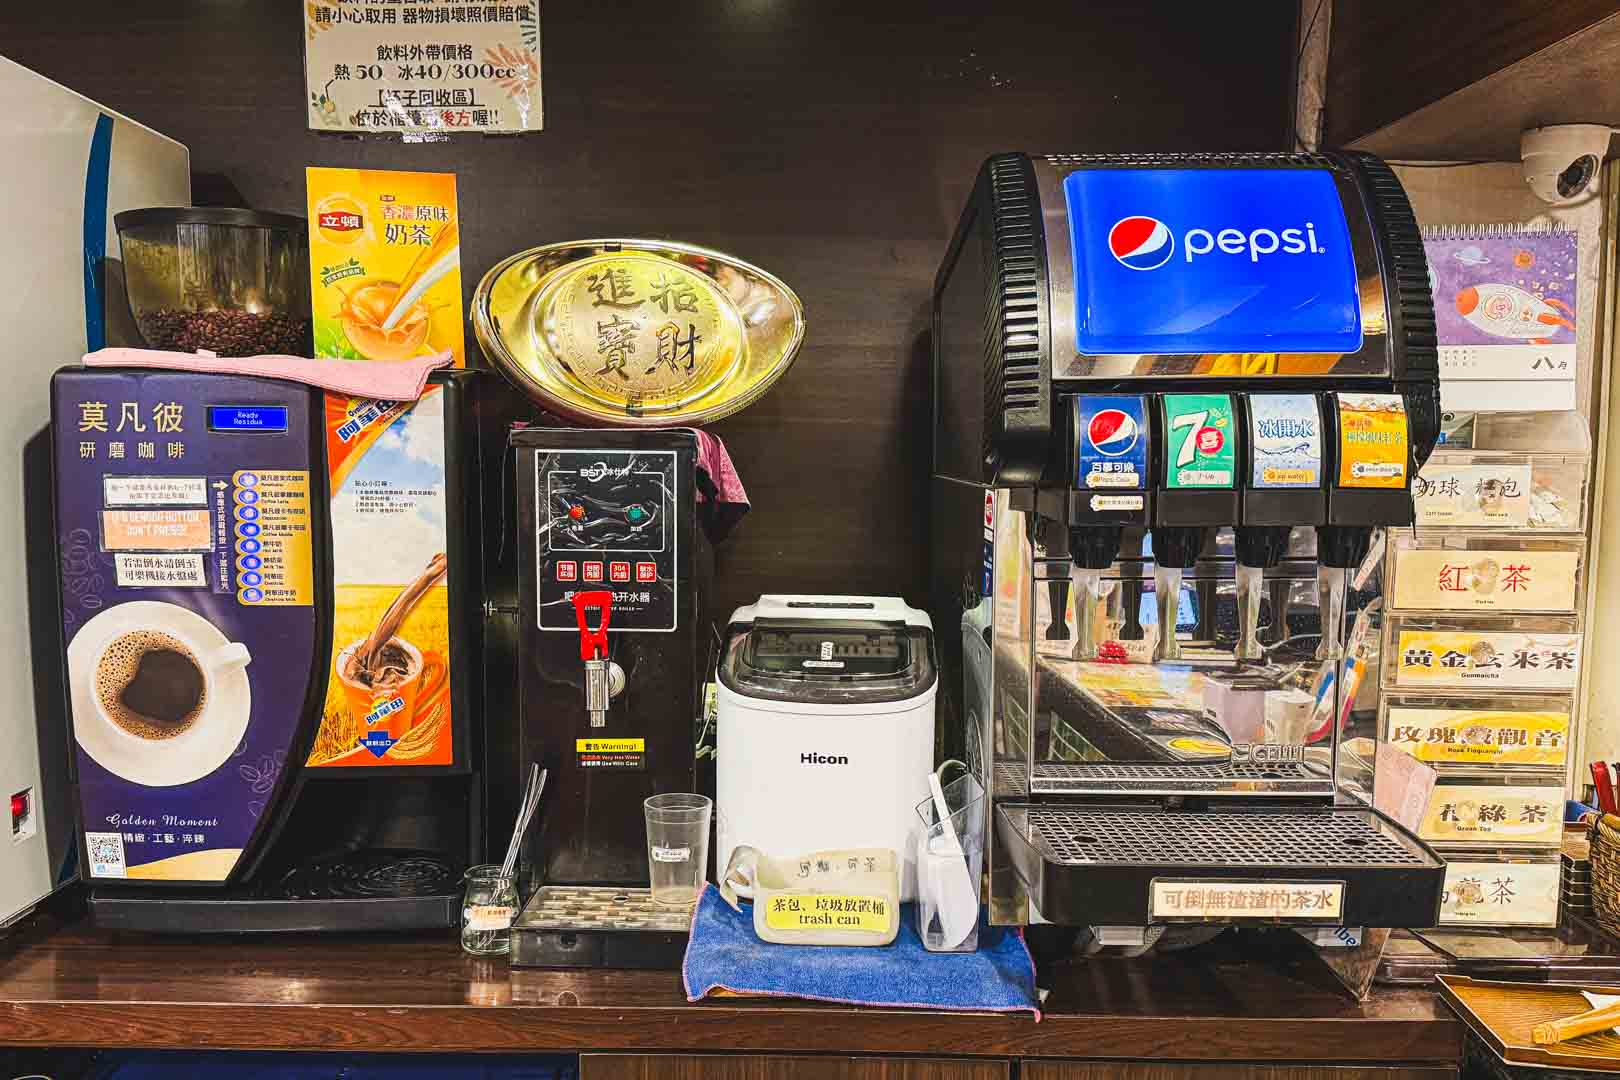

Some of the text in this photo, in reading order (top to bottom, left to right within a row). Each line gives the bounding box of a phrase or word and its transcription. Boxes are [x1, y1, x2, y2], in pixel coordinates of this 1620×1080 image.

[315, 6, 530, 24] 請小心取用 器物損壞照價賠償
[376, 44, 473, 61] 飲料外帶價格
[334, 64, 350, 80] 熱
[355, 65, 383, 80] 50
[322, 215, 360, 228] 立頓
[385, 222, 432, 246] 奶茶
[1184, 222, 1318, 263] pepsi
[78, 401, 184, 433] 莫凡彼
[1258, 419, 1314, 438] 冰開水
[79, 441, 184, 459] 研磨咖啡
[1091, 462, 1135, 473] 百事可樂
[1415, 476, 1461, 497] 奶球
[1439, 563, 1532, 593] 紅茶
[800, 752, 849, 765] Hicon
[106, 813, 218, 828] Golden Moment
[772, 897, 885, 916] 茶包、垃圾放置桶
[1163, 888, 1334, 910] 可倒無渣渣的茶水
[799, 912, 861, 925] trash can
